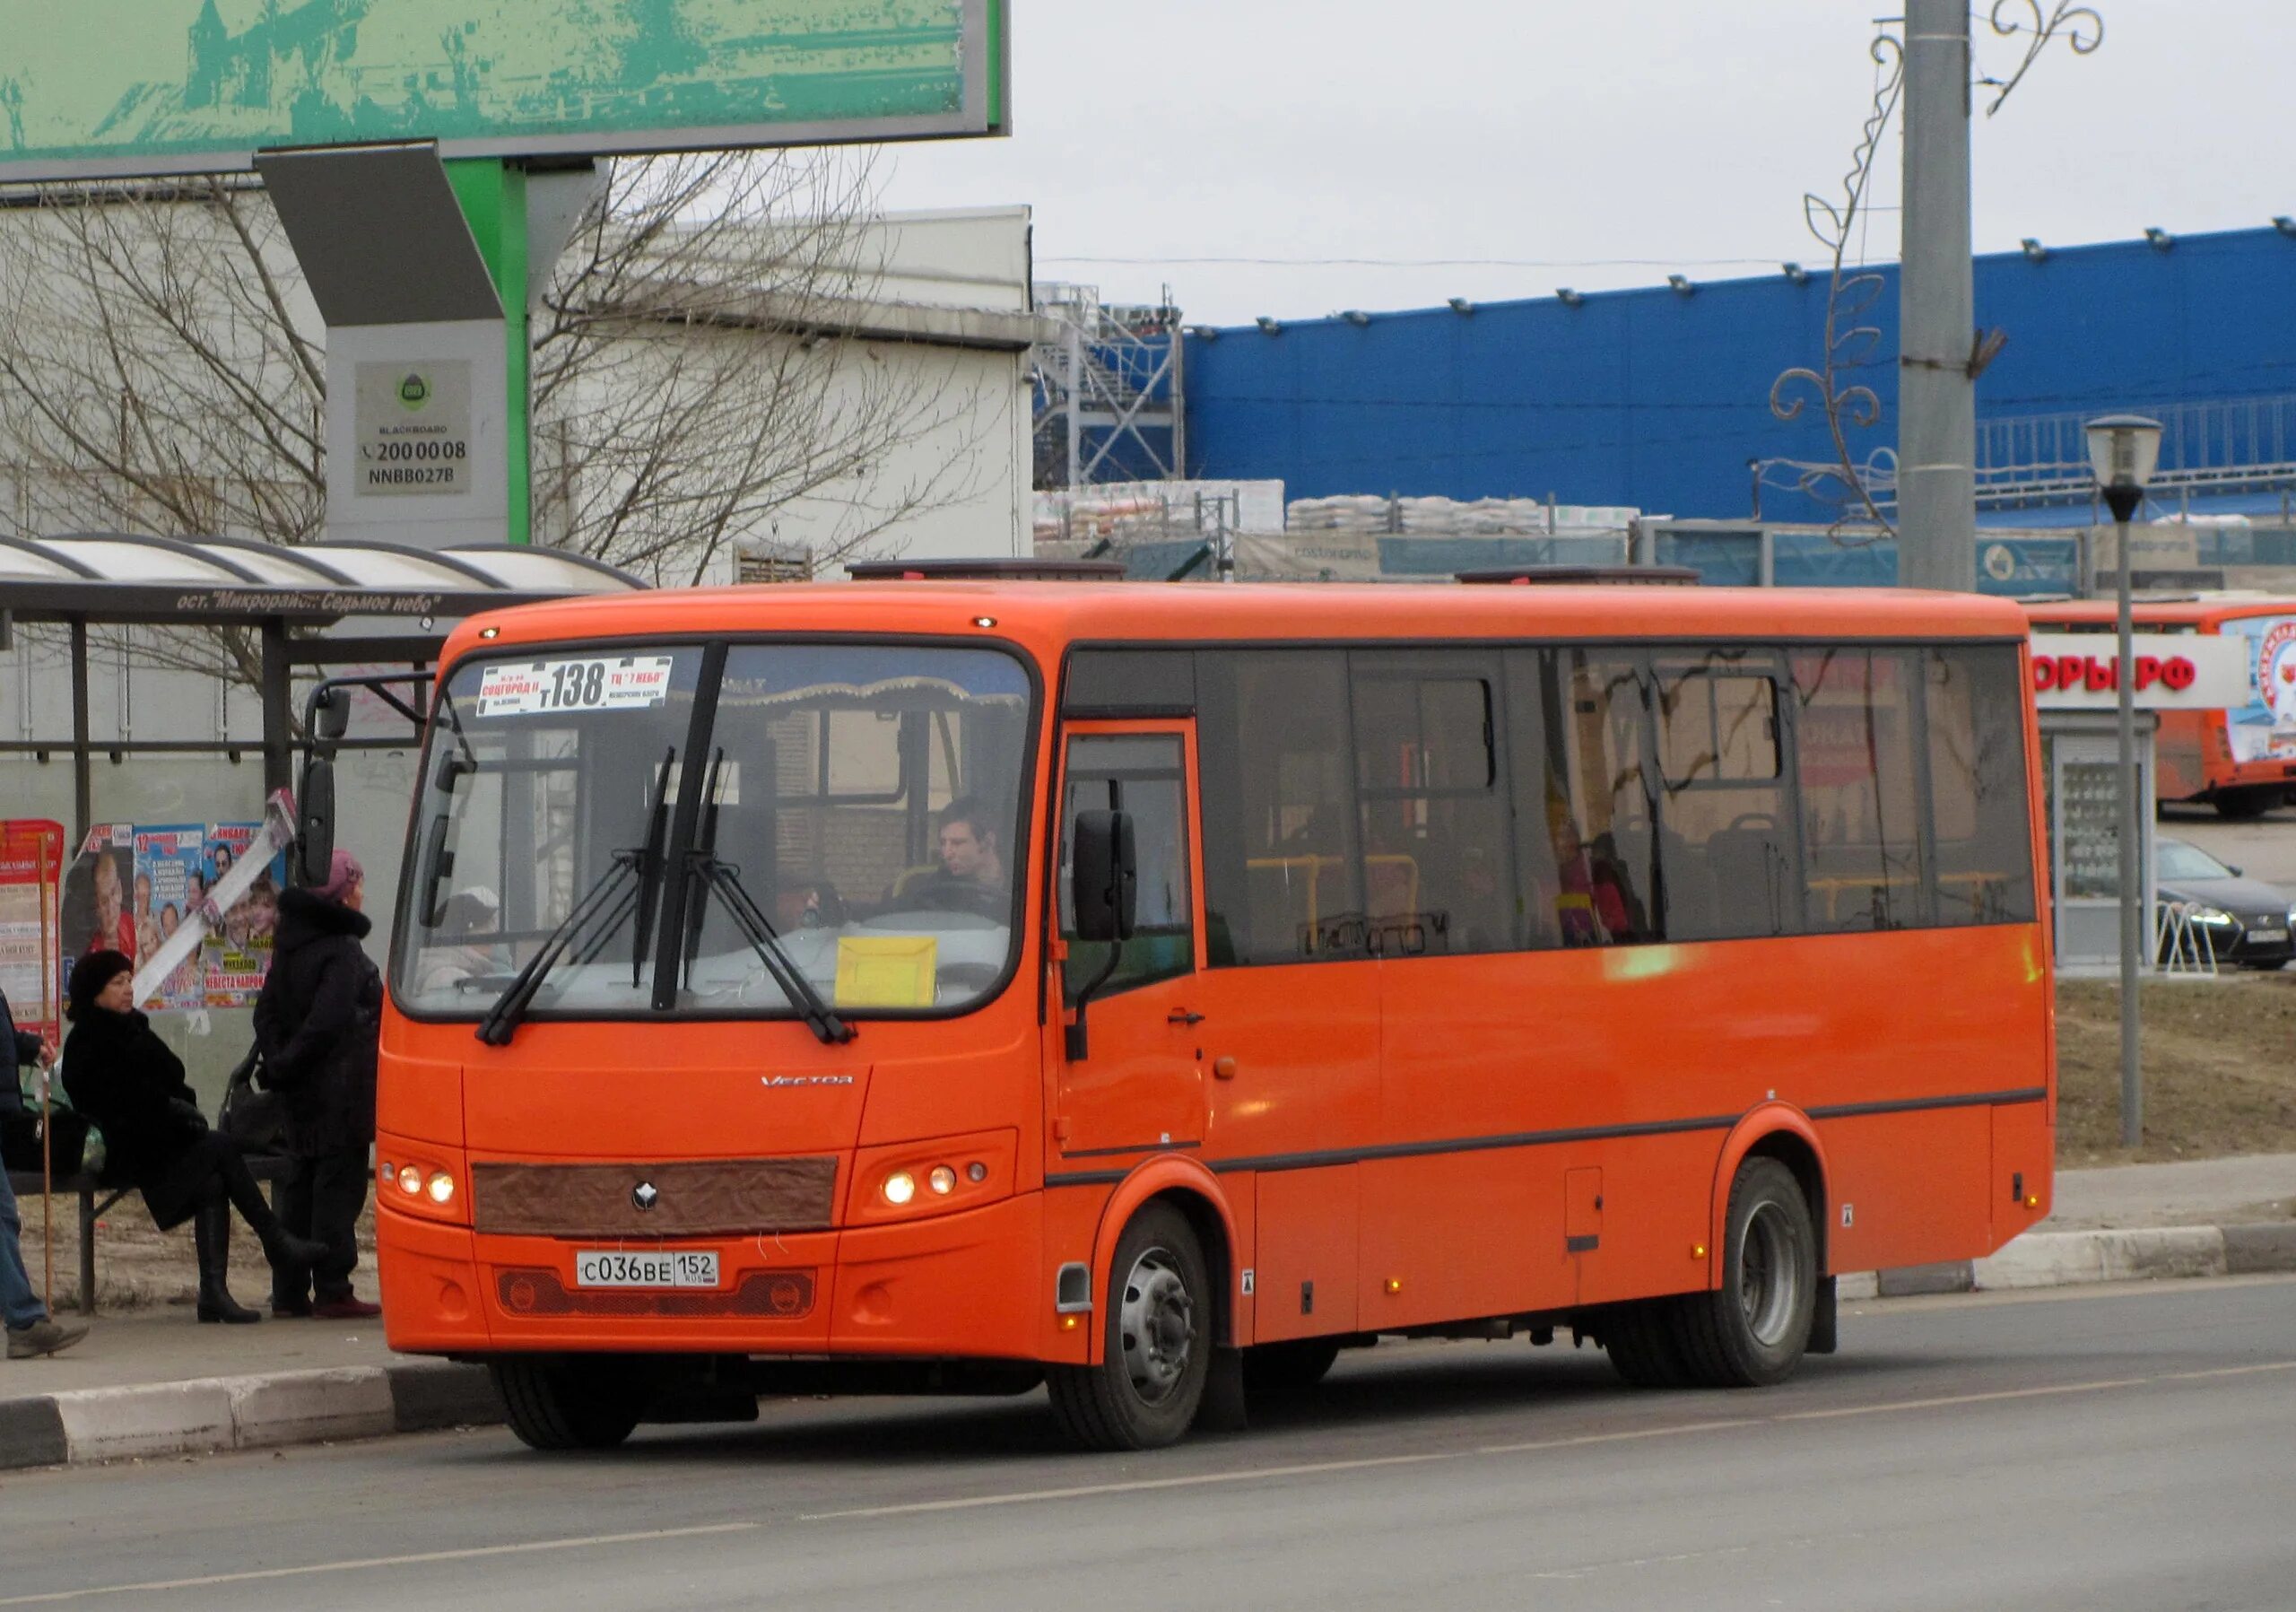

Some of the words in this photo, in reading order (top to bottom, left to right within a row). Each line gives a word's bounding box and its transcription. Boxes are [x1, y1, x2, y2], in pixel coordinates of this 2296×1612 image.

[320, 592, 387, 613] Седьмое
[611, 674, 623, 685] ТЦ
[482, 682, 531, 697] СОЦГОРОД
[677, 1255, 712, 1276] 152
